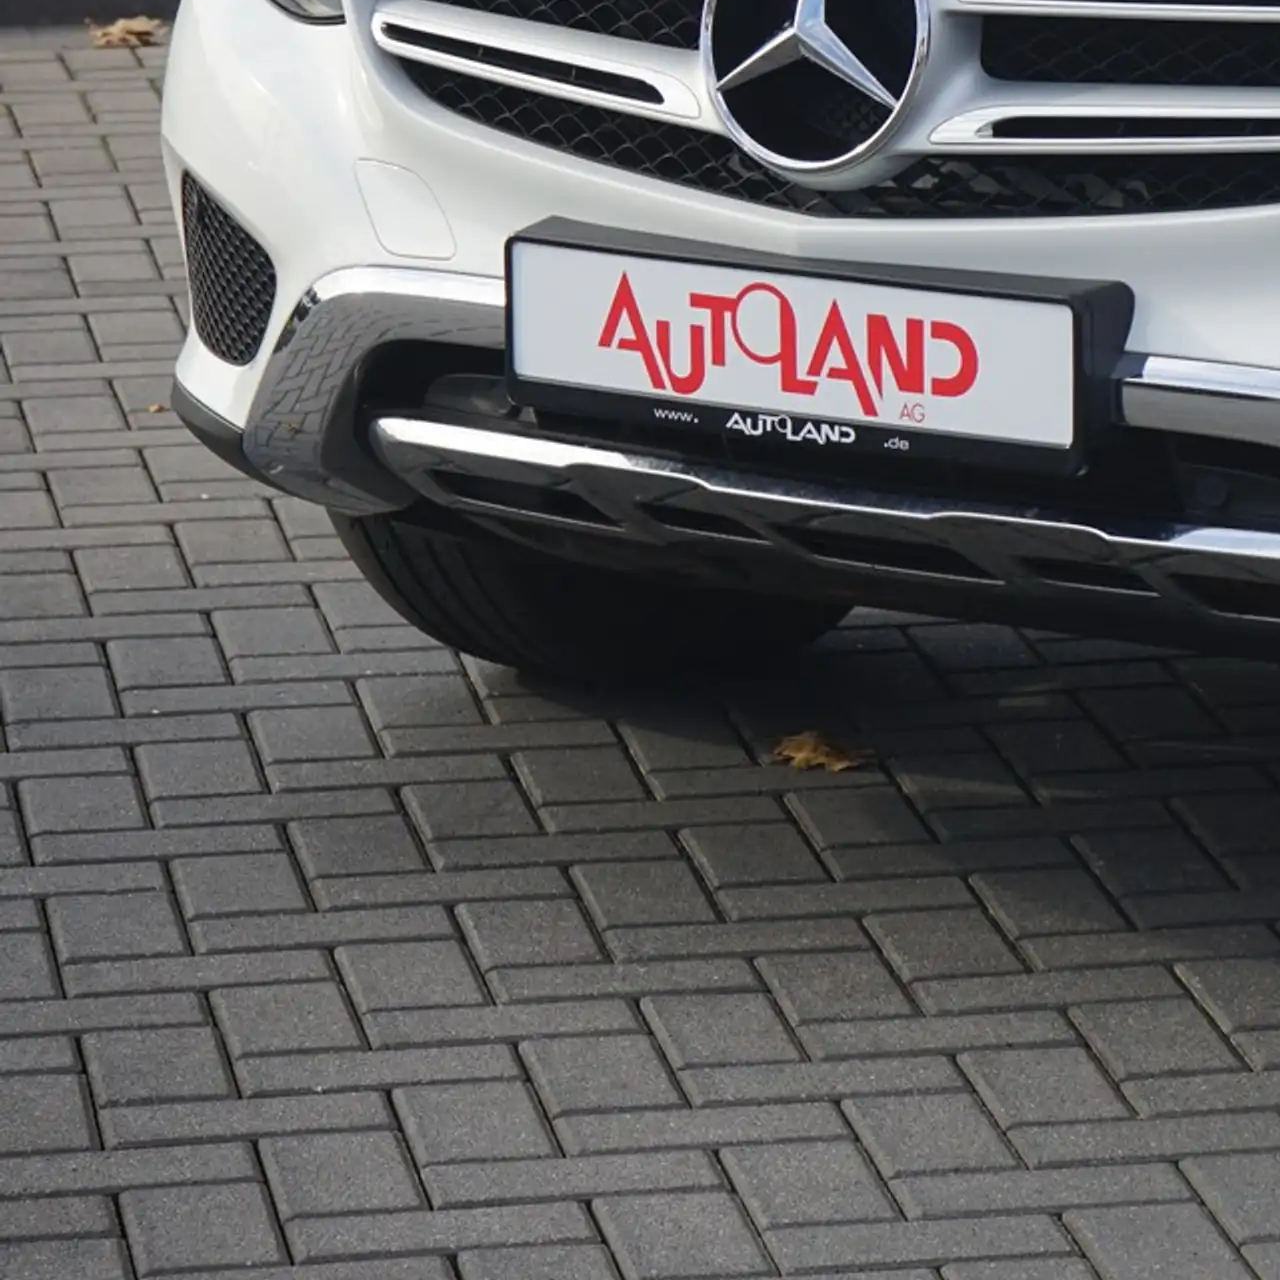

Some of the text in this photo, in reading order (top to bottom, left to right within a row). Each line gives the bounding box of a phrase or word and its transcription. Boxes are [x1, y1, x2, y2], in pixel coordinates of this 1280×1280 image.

[599, 272, 979, 417] AUTOLAND
[653, 407, 909, 450] www. AUTOLAND .de
[899, 403, 925, 423] AG
